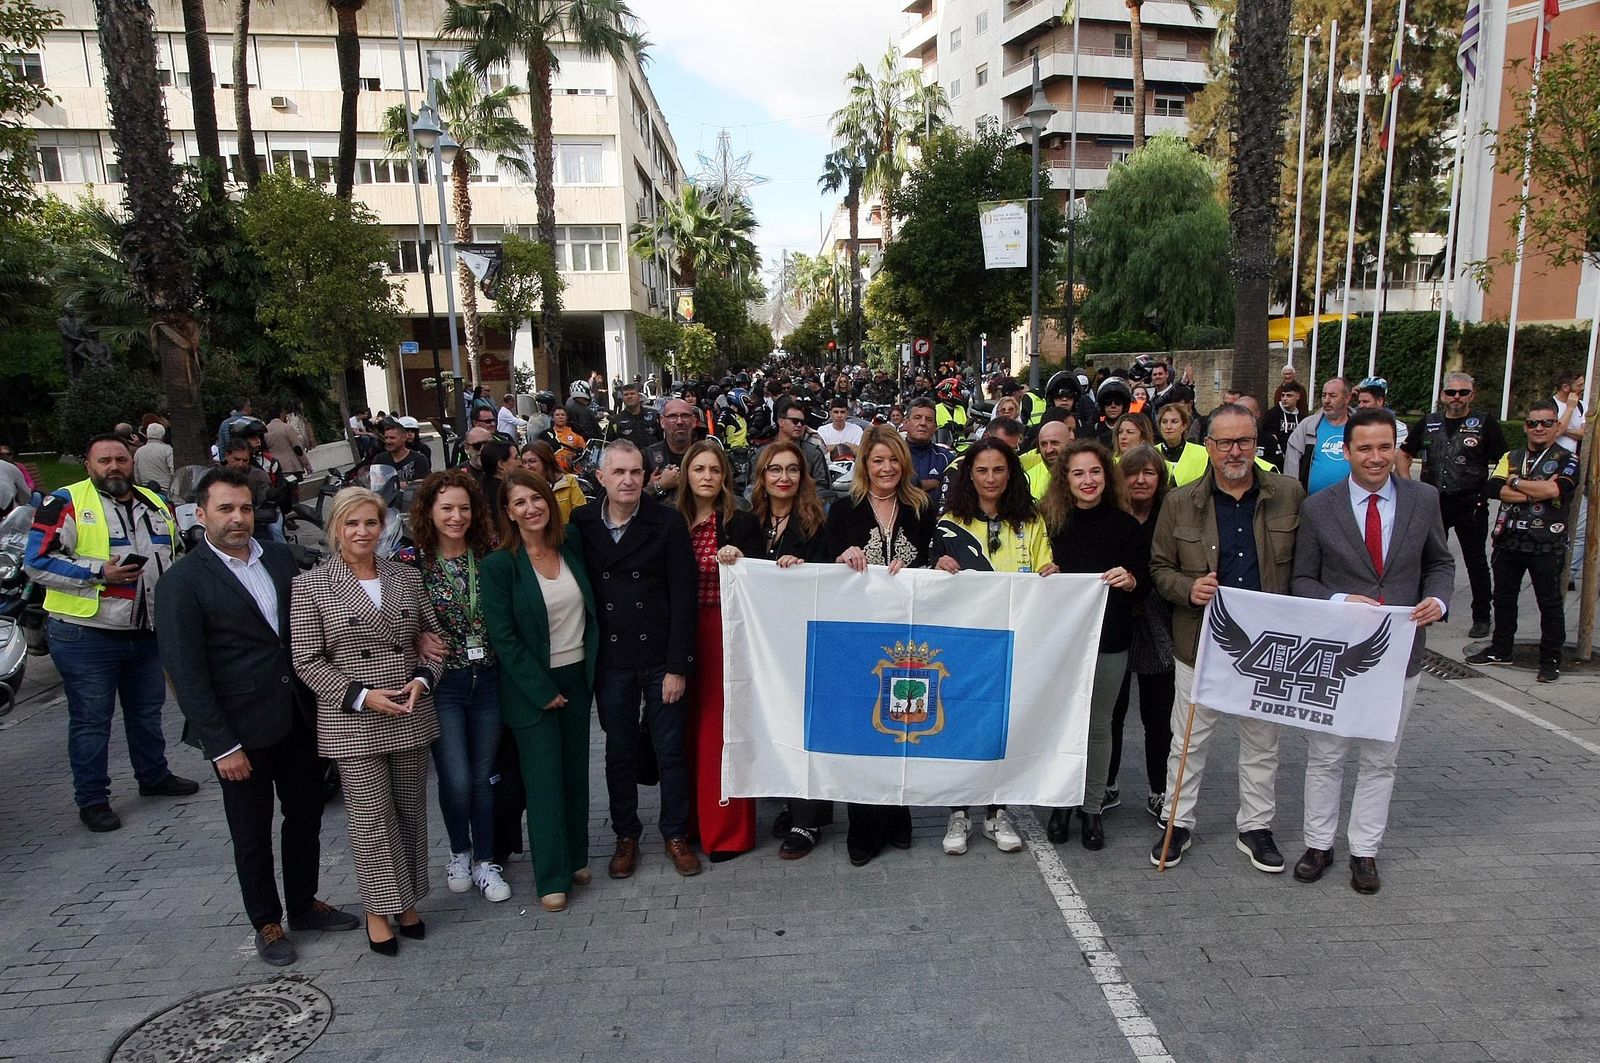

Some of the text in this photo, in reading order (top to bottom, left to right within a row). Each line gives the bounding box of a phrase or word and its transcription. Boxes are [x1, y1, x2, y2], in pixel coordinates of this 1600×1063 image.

[1232, 631, 1348, 710] 44
[1273, 644, 1287, 672] SUPER
[1320, 651, 1334, 678] HUGO
[1249, 699, 1334, 726] FOREVER
